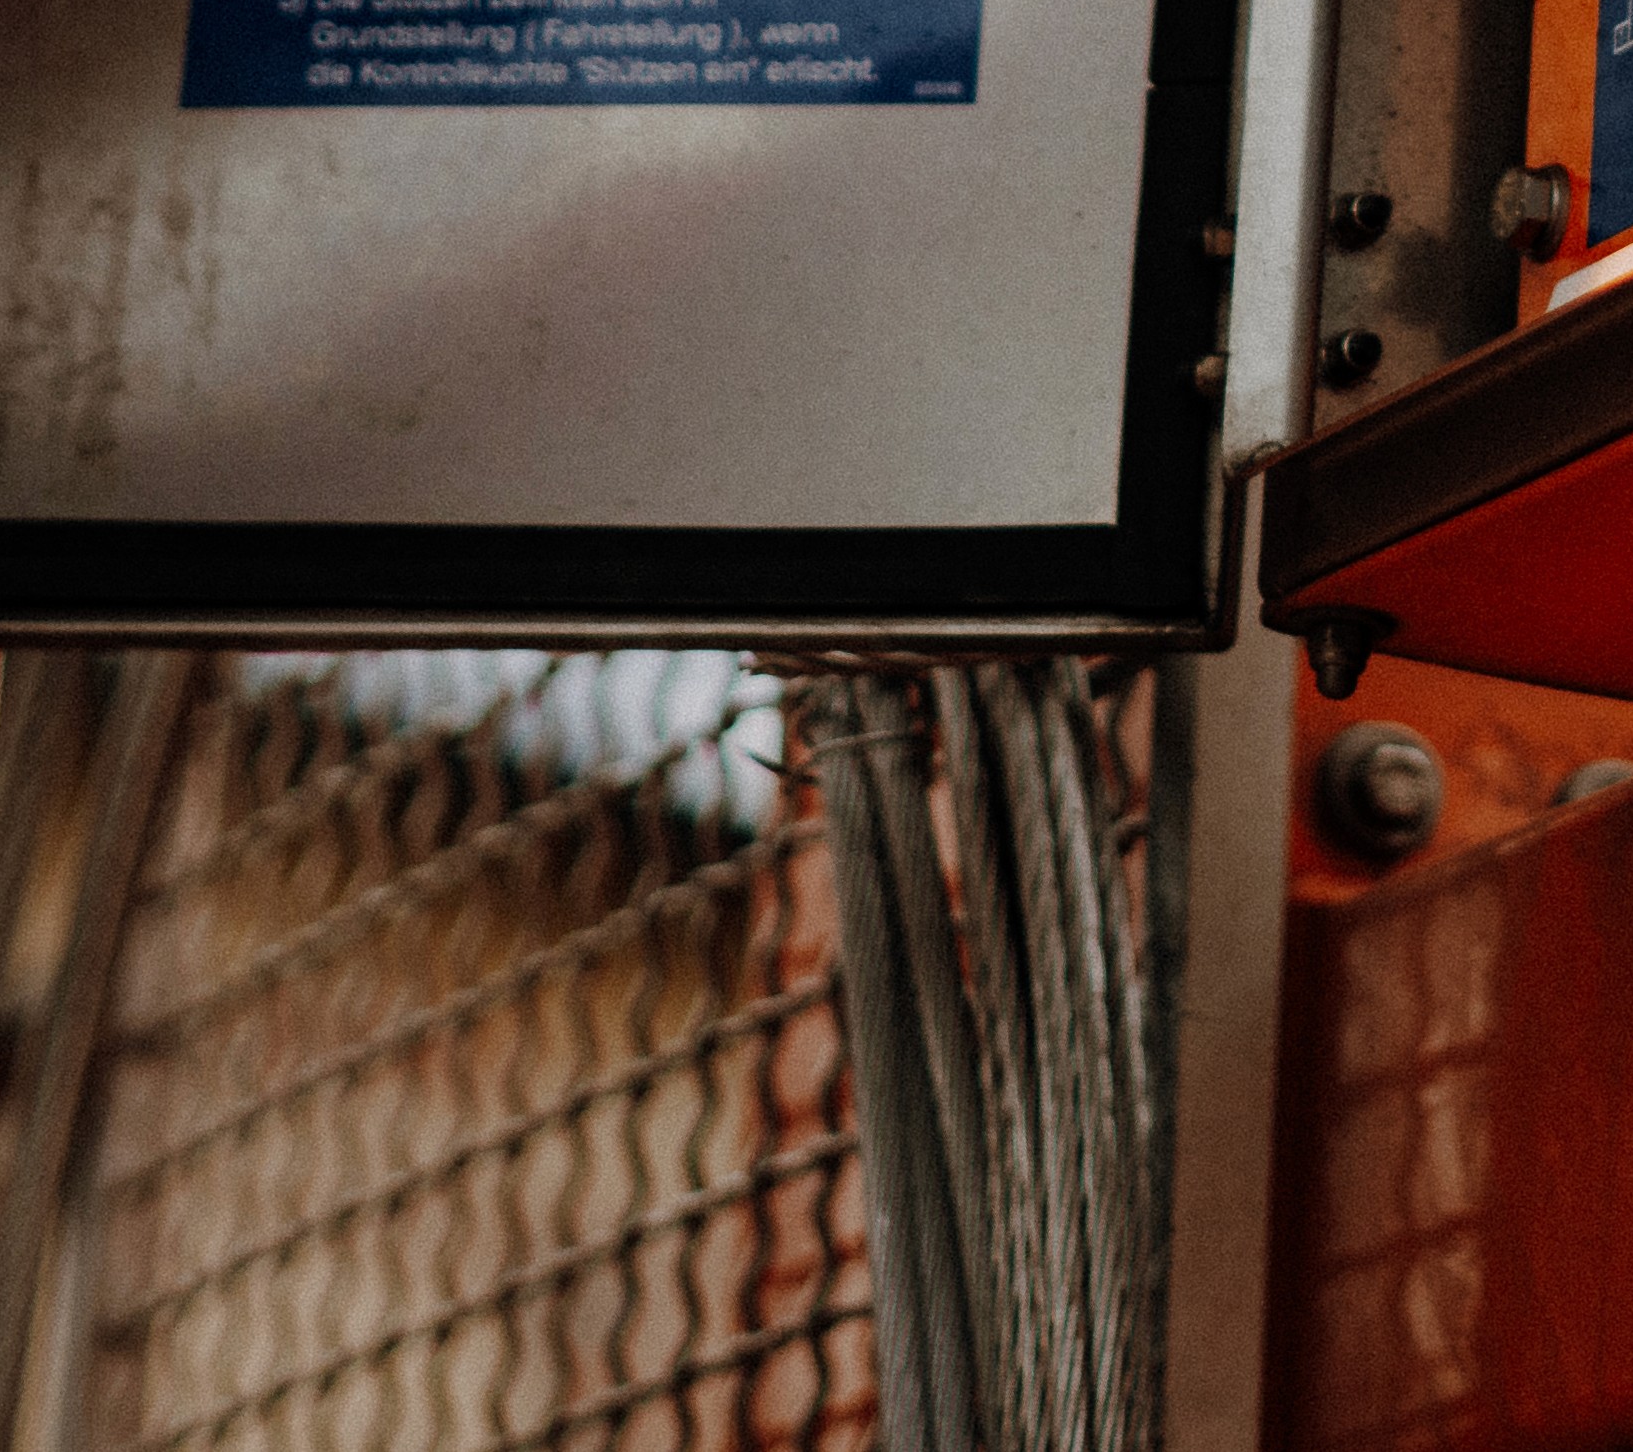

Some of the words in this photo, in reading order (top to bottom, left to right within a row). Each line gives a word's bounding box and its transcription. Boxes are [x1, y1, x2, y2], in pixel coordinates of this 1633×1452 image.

[310, 19, 518, 52] Grundstellung
[544, 17, 724, 51] Fahrstellung
[761, 22, 841, 47] wenn
[305, 58, 354, 87] die
